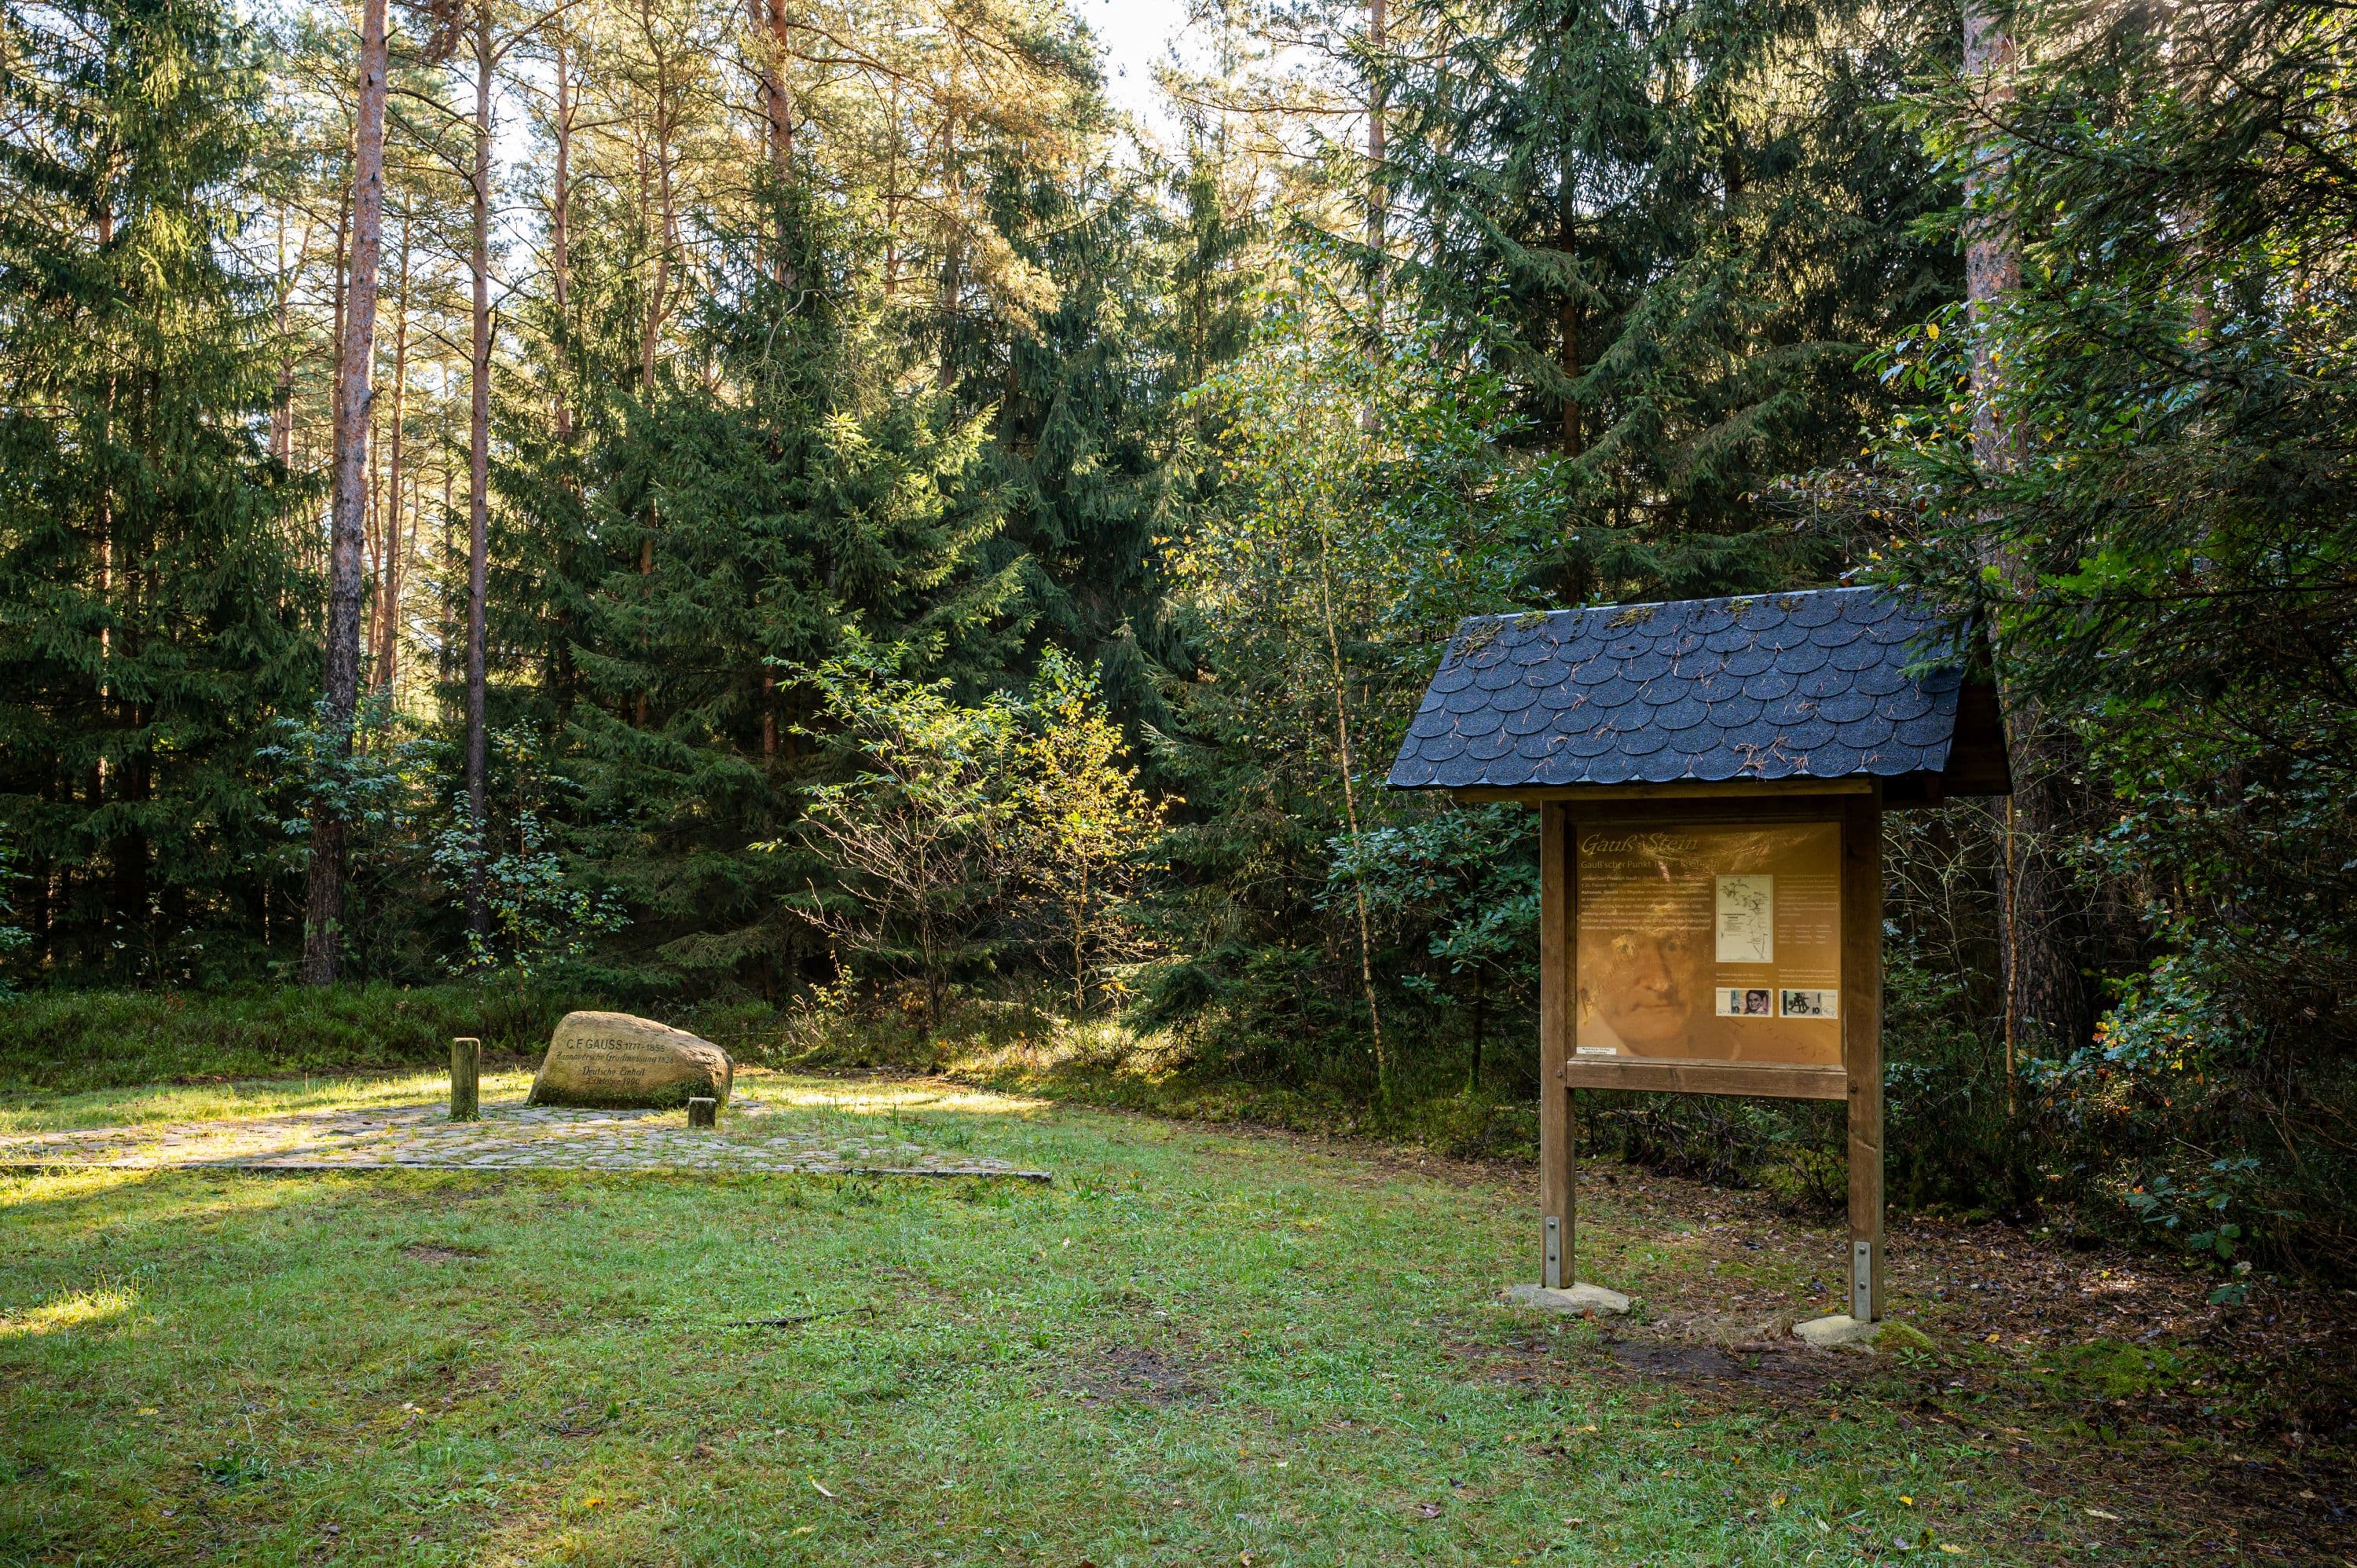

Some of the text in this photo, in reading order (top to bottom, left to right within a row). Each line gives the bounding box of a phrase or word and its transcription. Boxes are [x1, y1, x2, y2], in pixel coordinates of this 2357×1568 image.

[1582, 831, 1697, 855] Gauß Stein
[585, 1039, 623, 1050] GAUSS
[556, 1050, 604, 1061] Hannoversche
[606, 1051, 658, 1064] Gradmessung
[582, 1065, 646, 1076] Deutsche Einheit
[593, 1076, 621, 1086] Oktober
